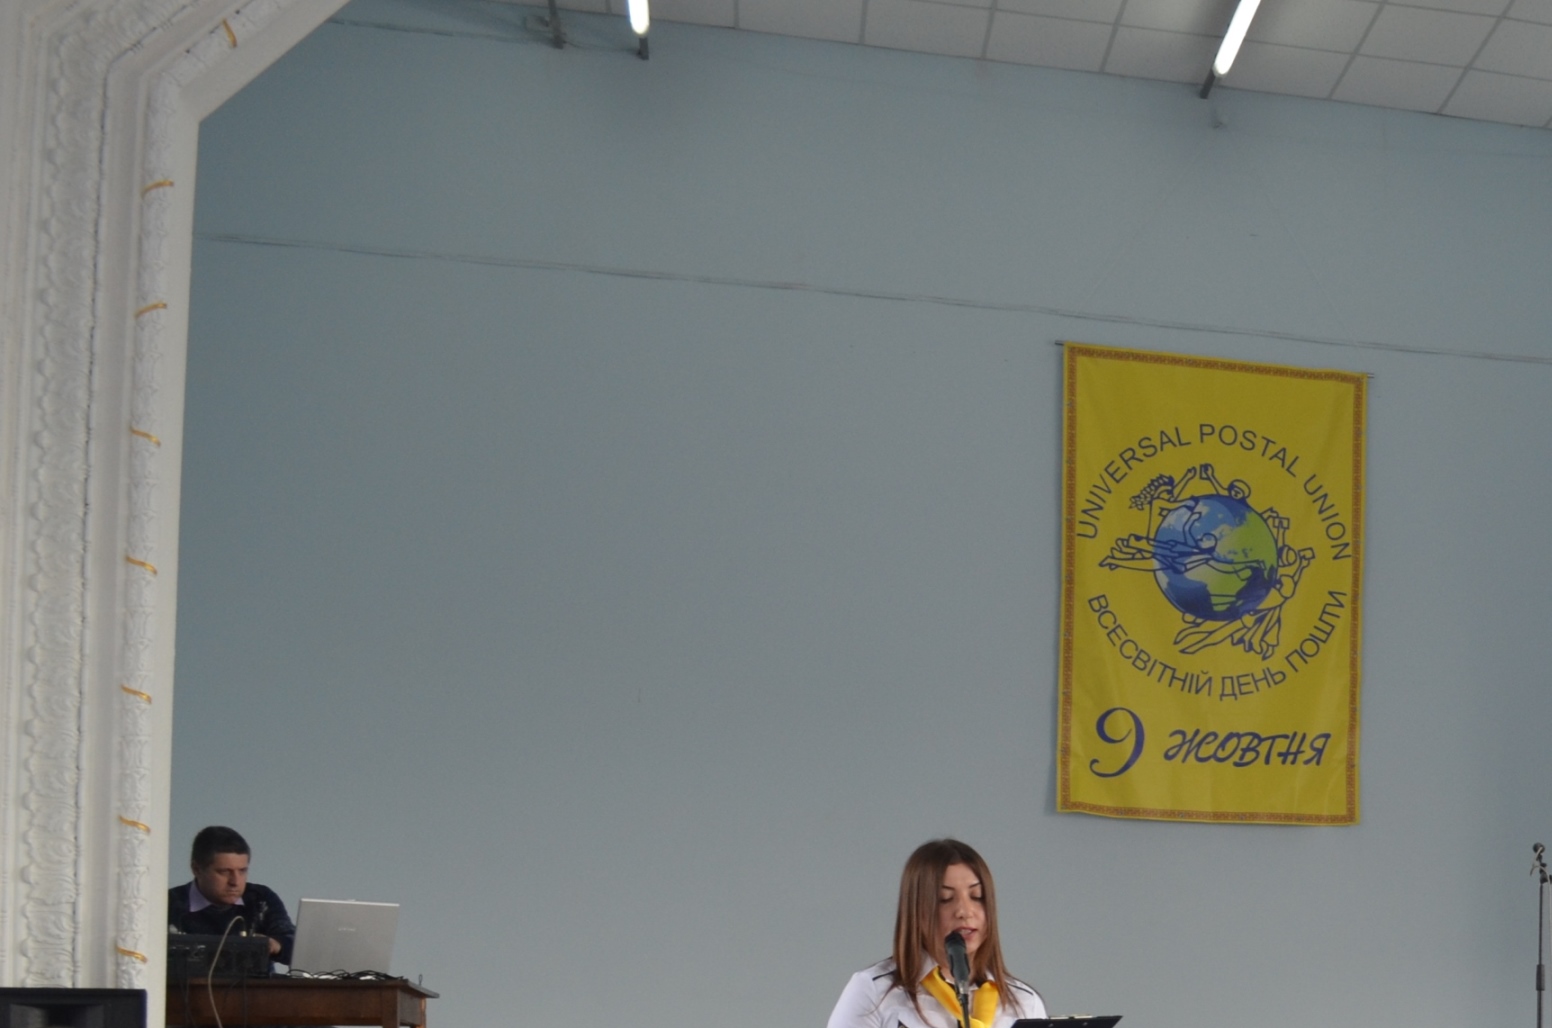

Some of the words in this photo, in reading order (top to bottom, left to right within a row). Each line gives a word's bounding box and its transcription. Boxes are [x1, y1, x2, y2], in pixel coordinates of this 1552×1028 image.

[1076, 426, 1191, 539] UNIVERSAL
[1199, 423, 1301, 477] POSTAL
[1302, 474, 1352, 561] UNION
[1087, 594, 1213, 697] ВСЕСВІТНІЙ
[1218, 667, 1287, 701] ДЕНЬ
[1285, 590, 1347, 674] ПОШТИ
[1089, 706, 1146, 778] 9
